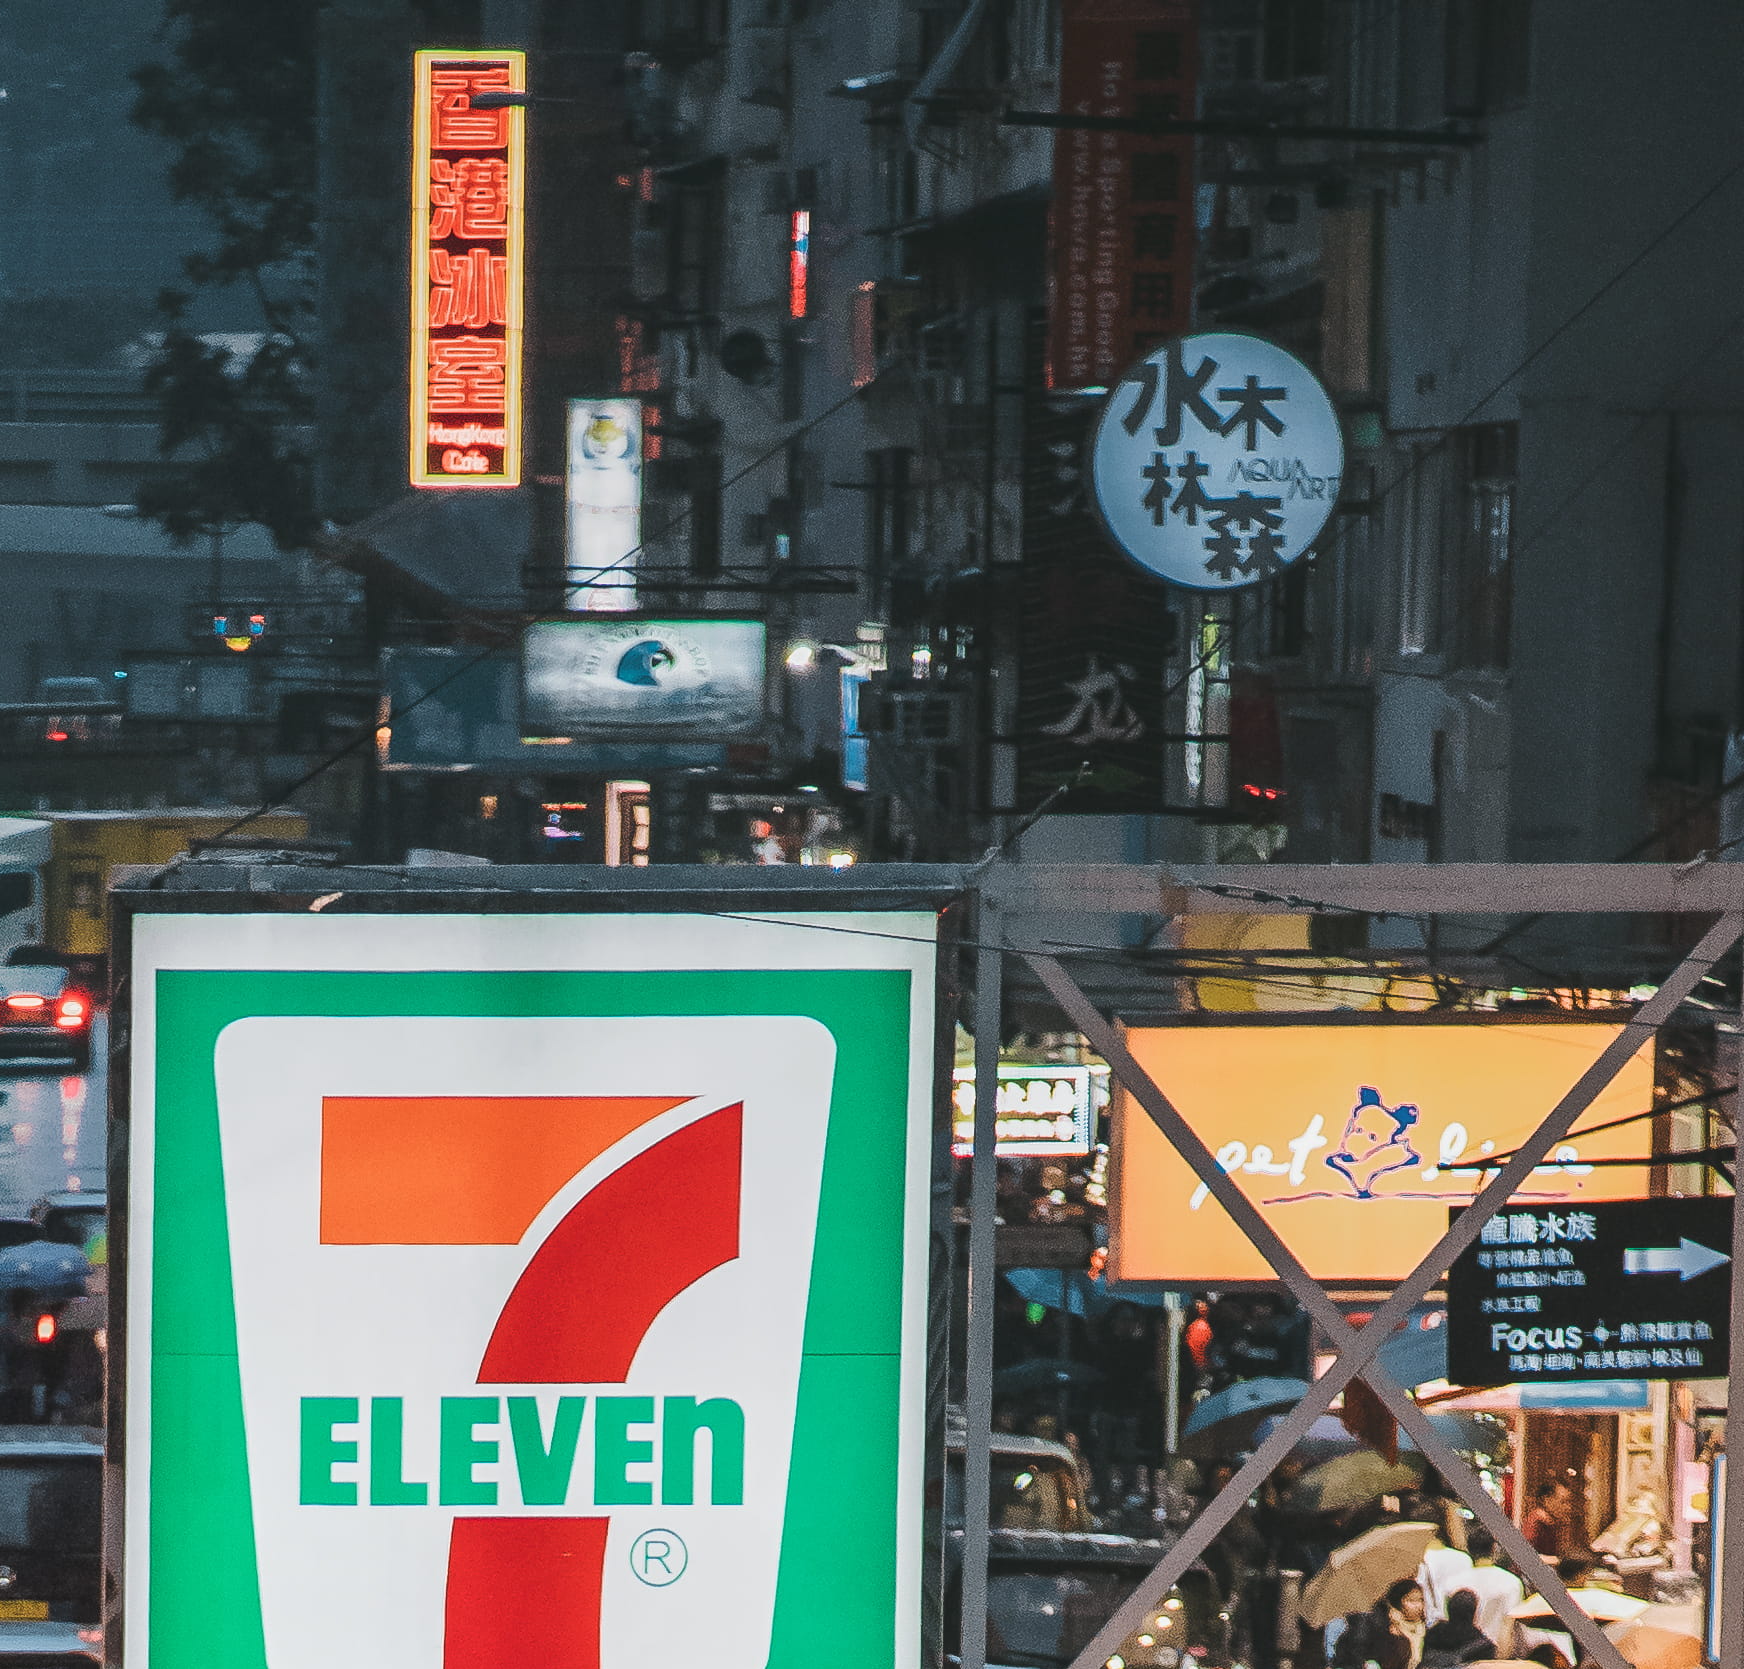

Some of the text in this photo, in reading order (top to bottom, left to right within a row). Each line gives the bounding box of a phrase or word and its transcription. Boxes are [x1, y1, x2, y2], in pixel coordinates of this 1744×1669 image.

[429, 68, 510, 413] 香港冰室
[1420, 1121, 1595, 1183] lie
[1490, 1322, 1584, 1351] Focus
